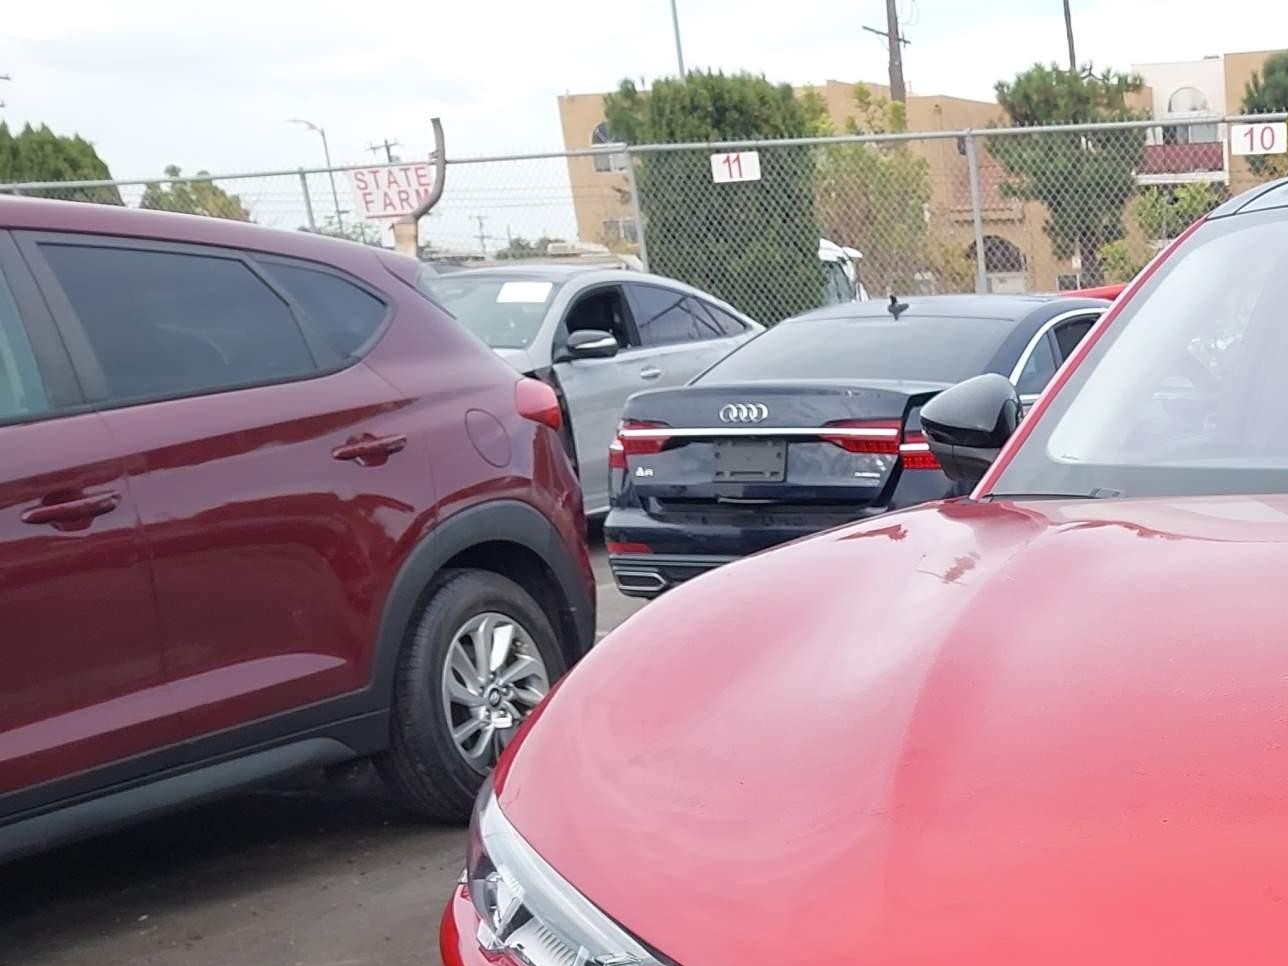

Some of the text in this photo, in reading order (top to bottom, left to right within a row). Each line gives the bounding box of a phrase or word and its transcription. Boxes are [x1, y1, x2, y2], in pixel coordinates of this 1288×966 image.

[1243, 126, 1275, 152] 10
[353, 166, 431, 191] STATE
[722, 154, 743, 178] 11
